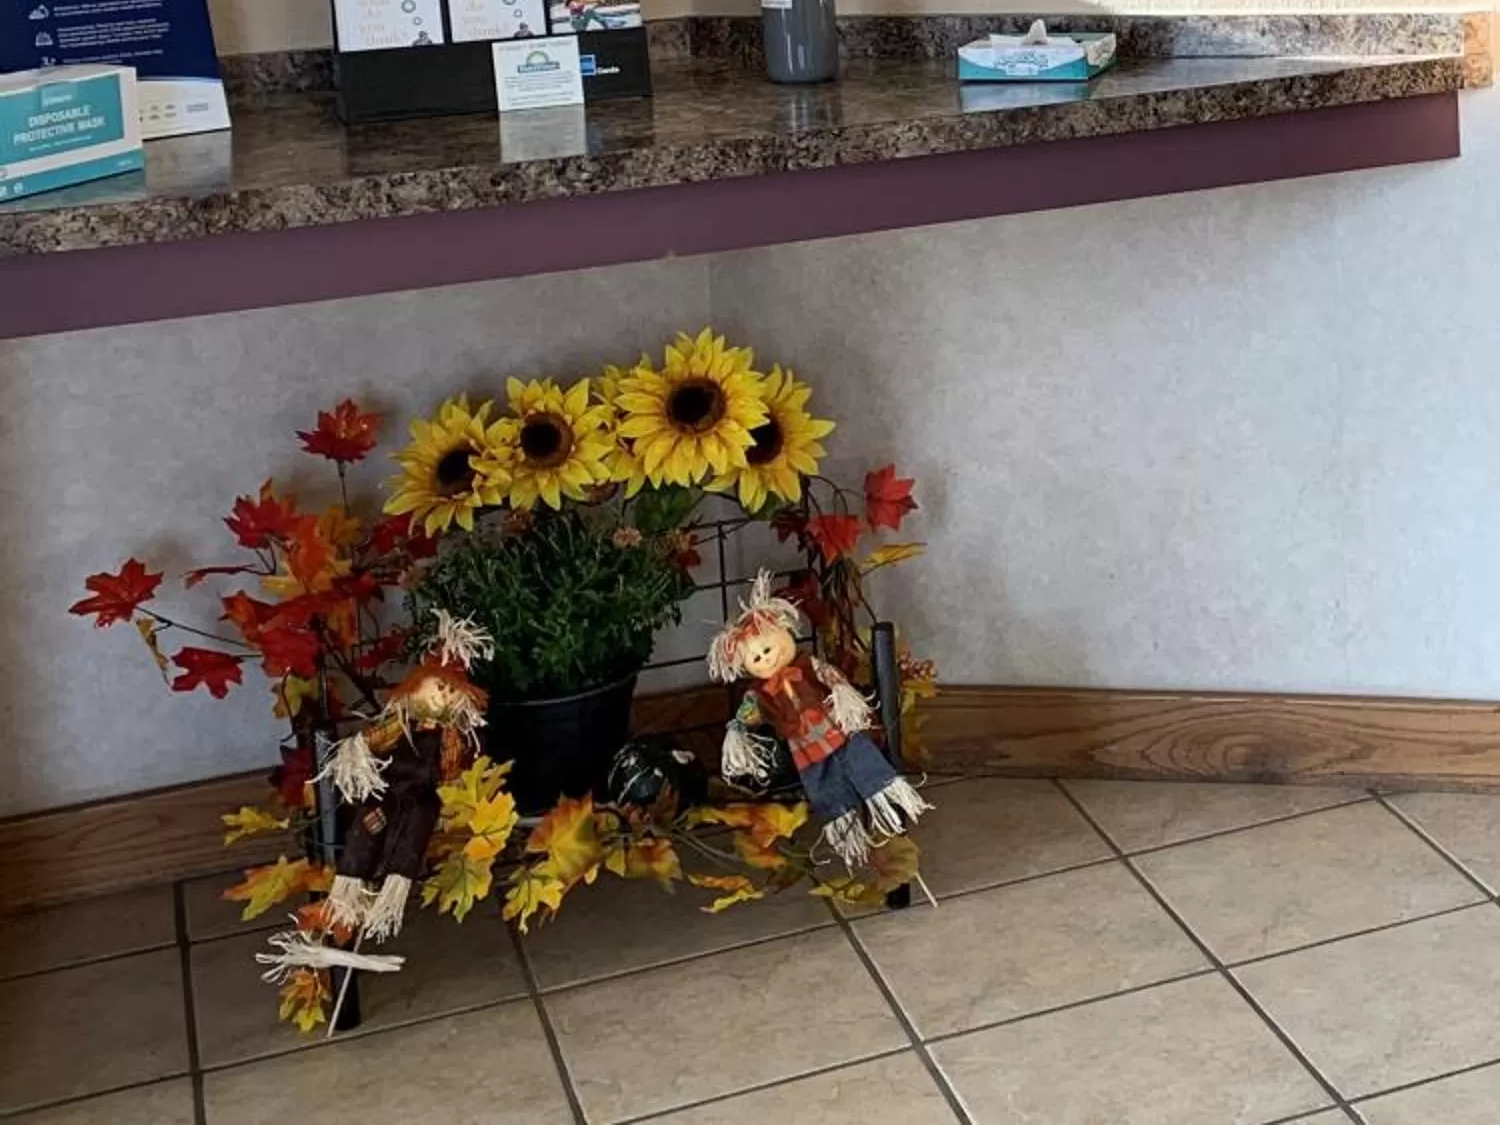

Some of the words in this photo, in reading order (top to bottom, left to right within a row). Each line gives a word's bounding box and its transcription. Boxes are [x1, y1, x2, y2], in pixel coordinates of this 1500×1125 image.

[28, 104, 92, 129] DISPOSABLE
[13, 122, 75, 146] PROTECTIVE
[77, 116, 105, 132] MASK
